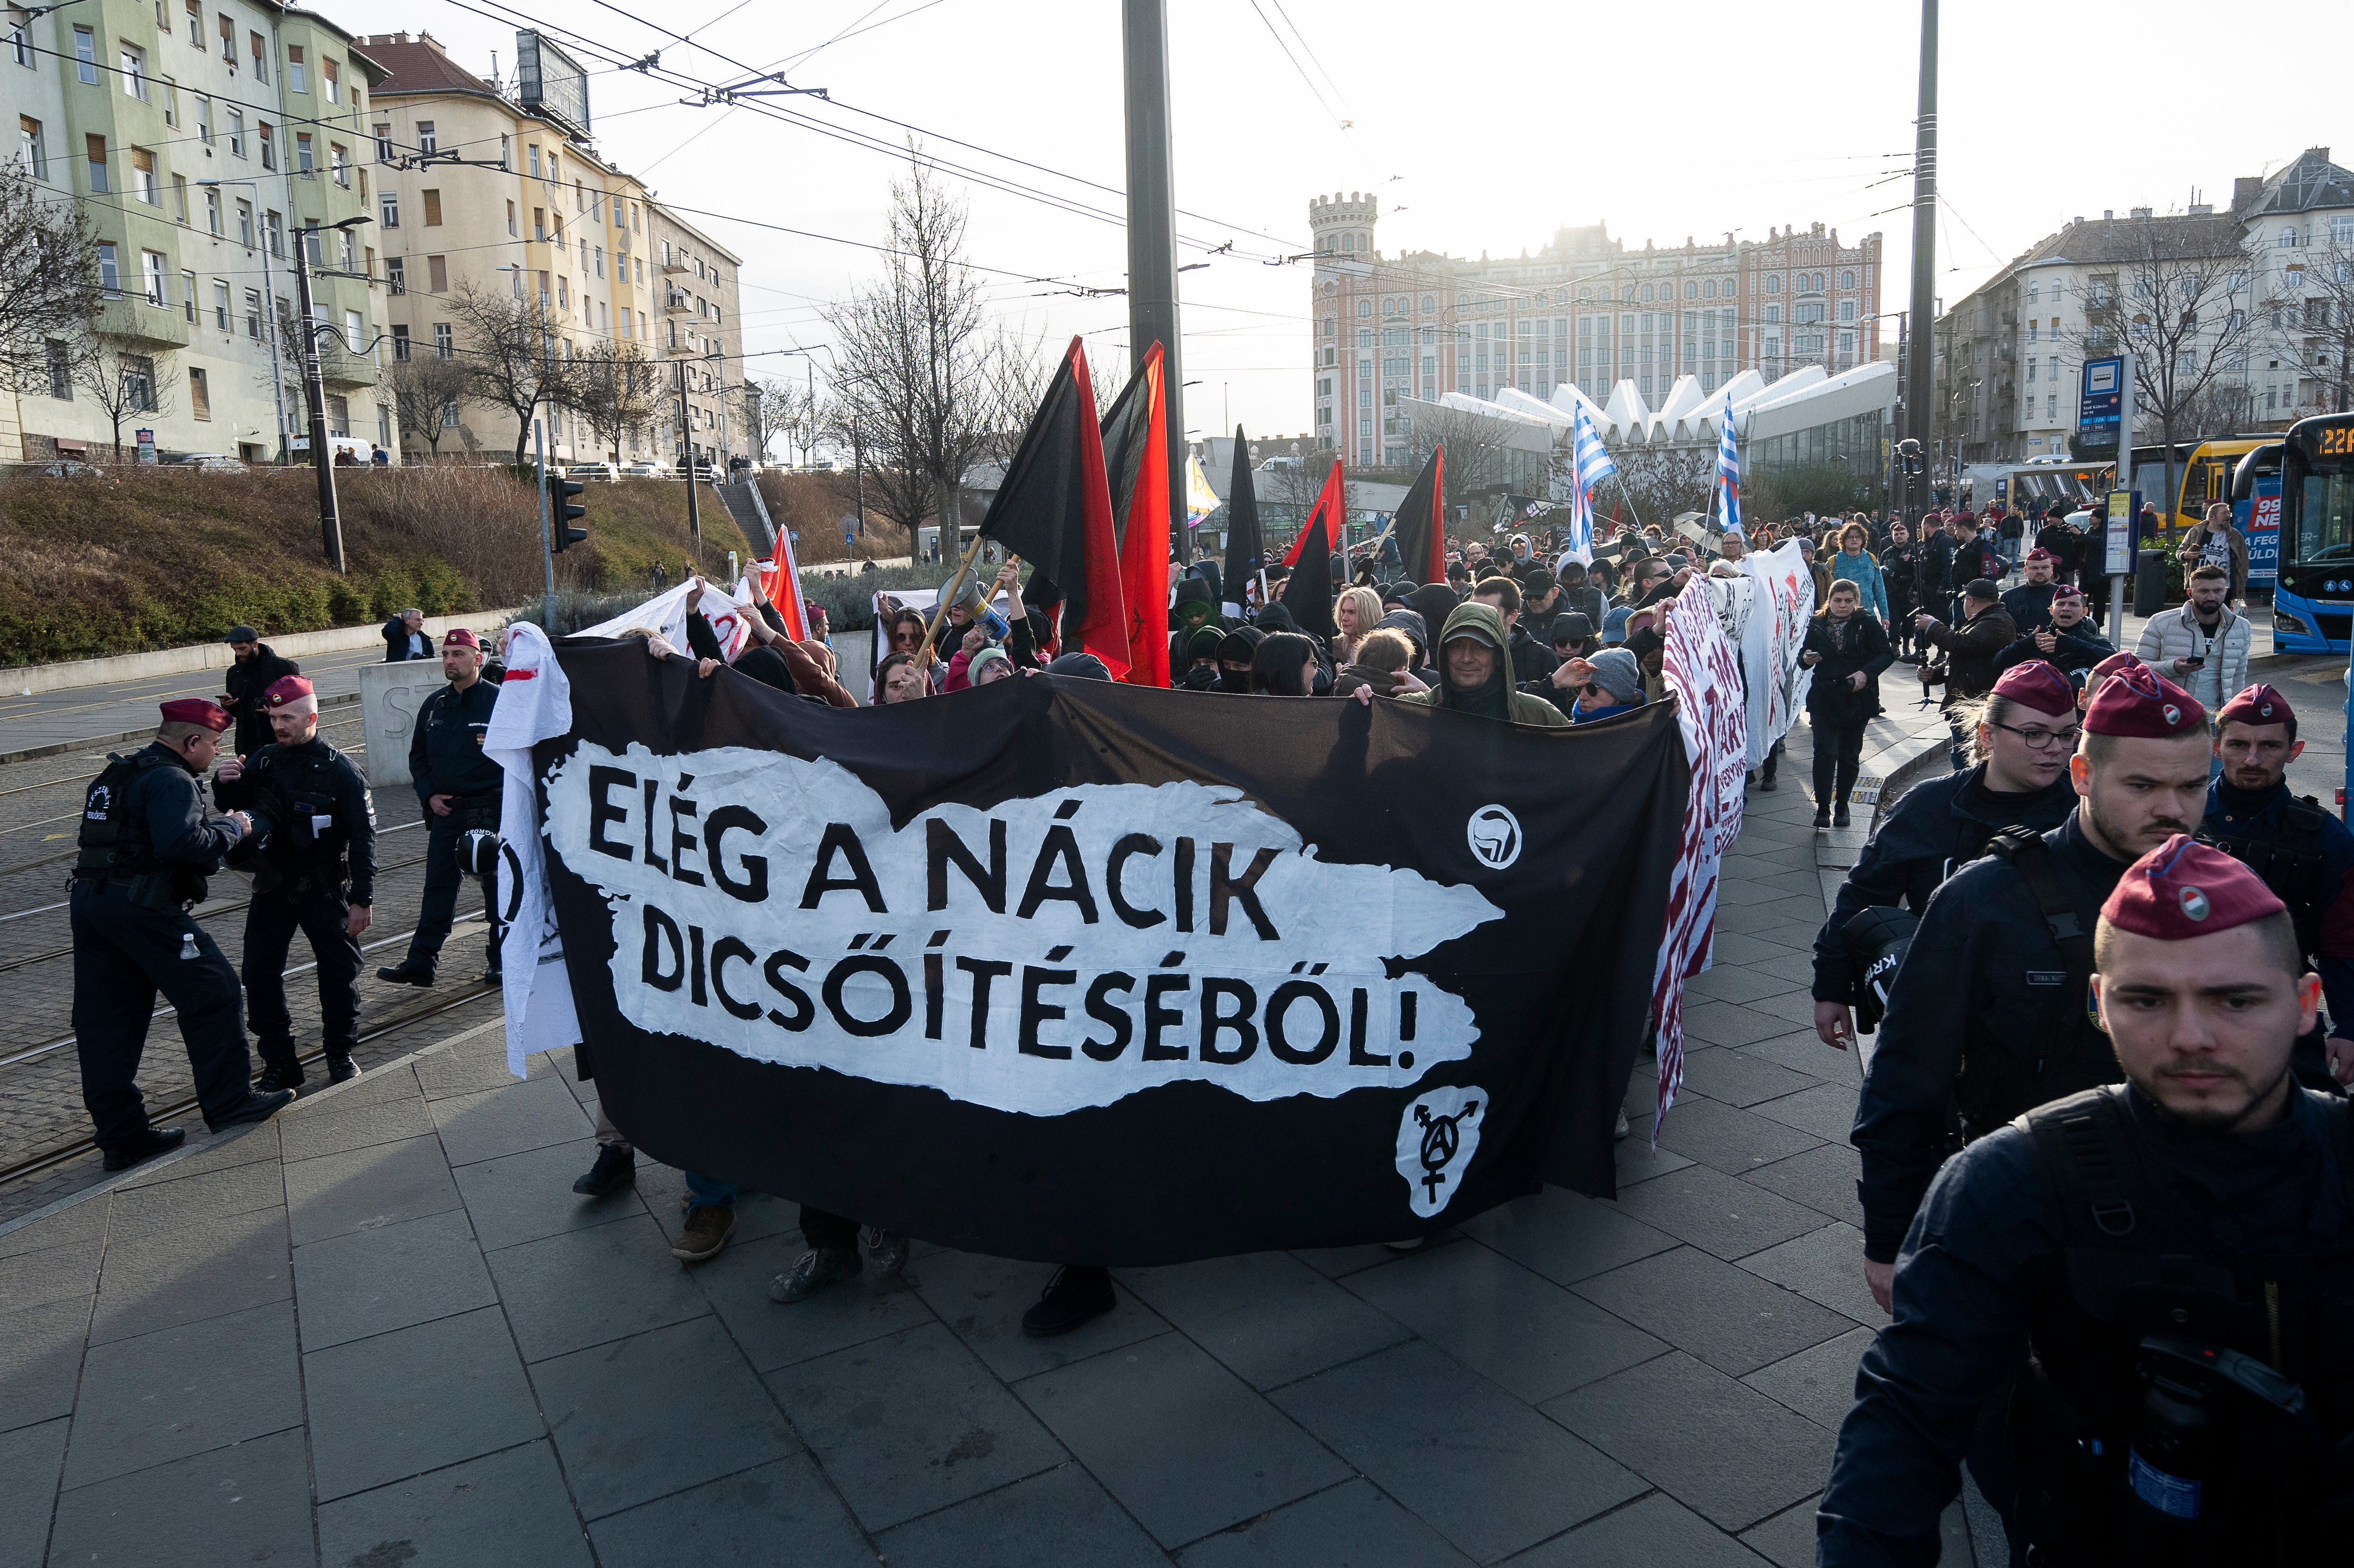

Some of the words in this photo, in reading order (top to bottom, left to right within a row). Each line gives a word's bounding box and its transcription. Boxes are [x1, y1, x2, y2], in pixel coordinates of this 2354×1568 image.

[2254, 513, 2279, 527] NE
[2258, 499, 2280, 513] 99
[589, 764, 768, 903] ELÉG
[798, 823, 889, 913] A
[926, 799, 1284, 941] NÁCIK
[641, 904, 1417, 1070] DICSŐÍTÉSÉBŐL!
